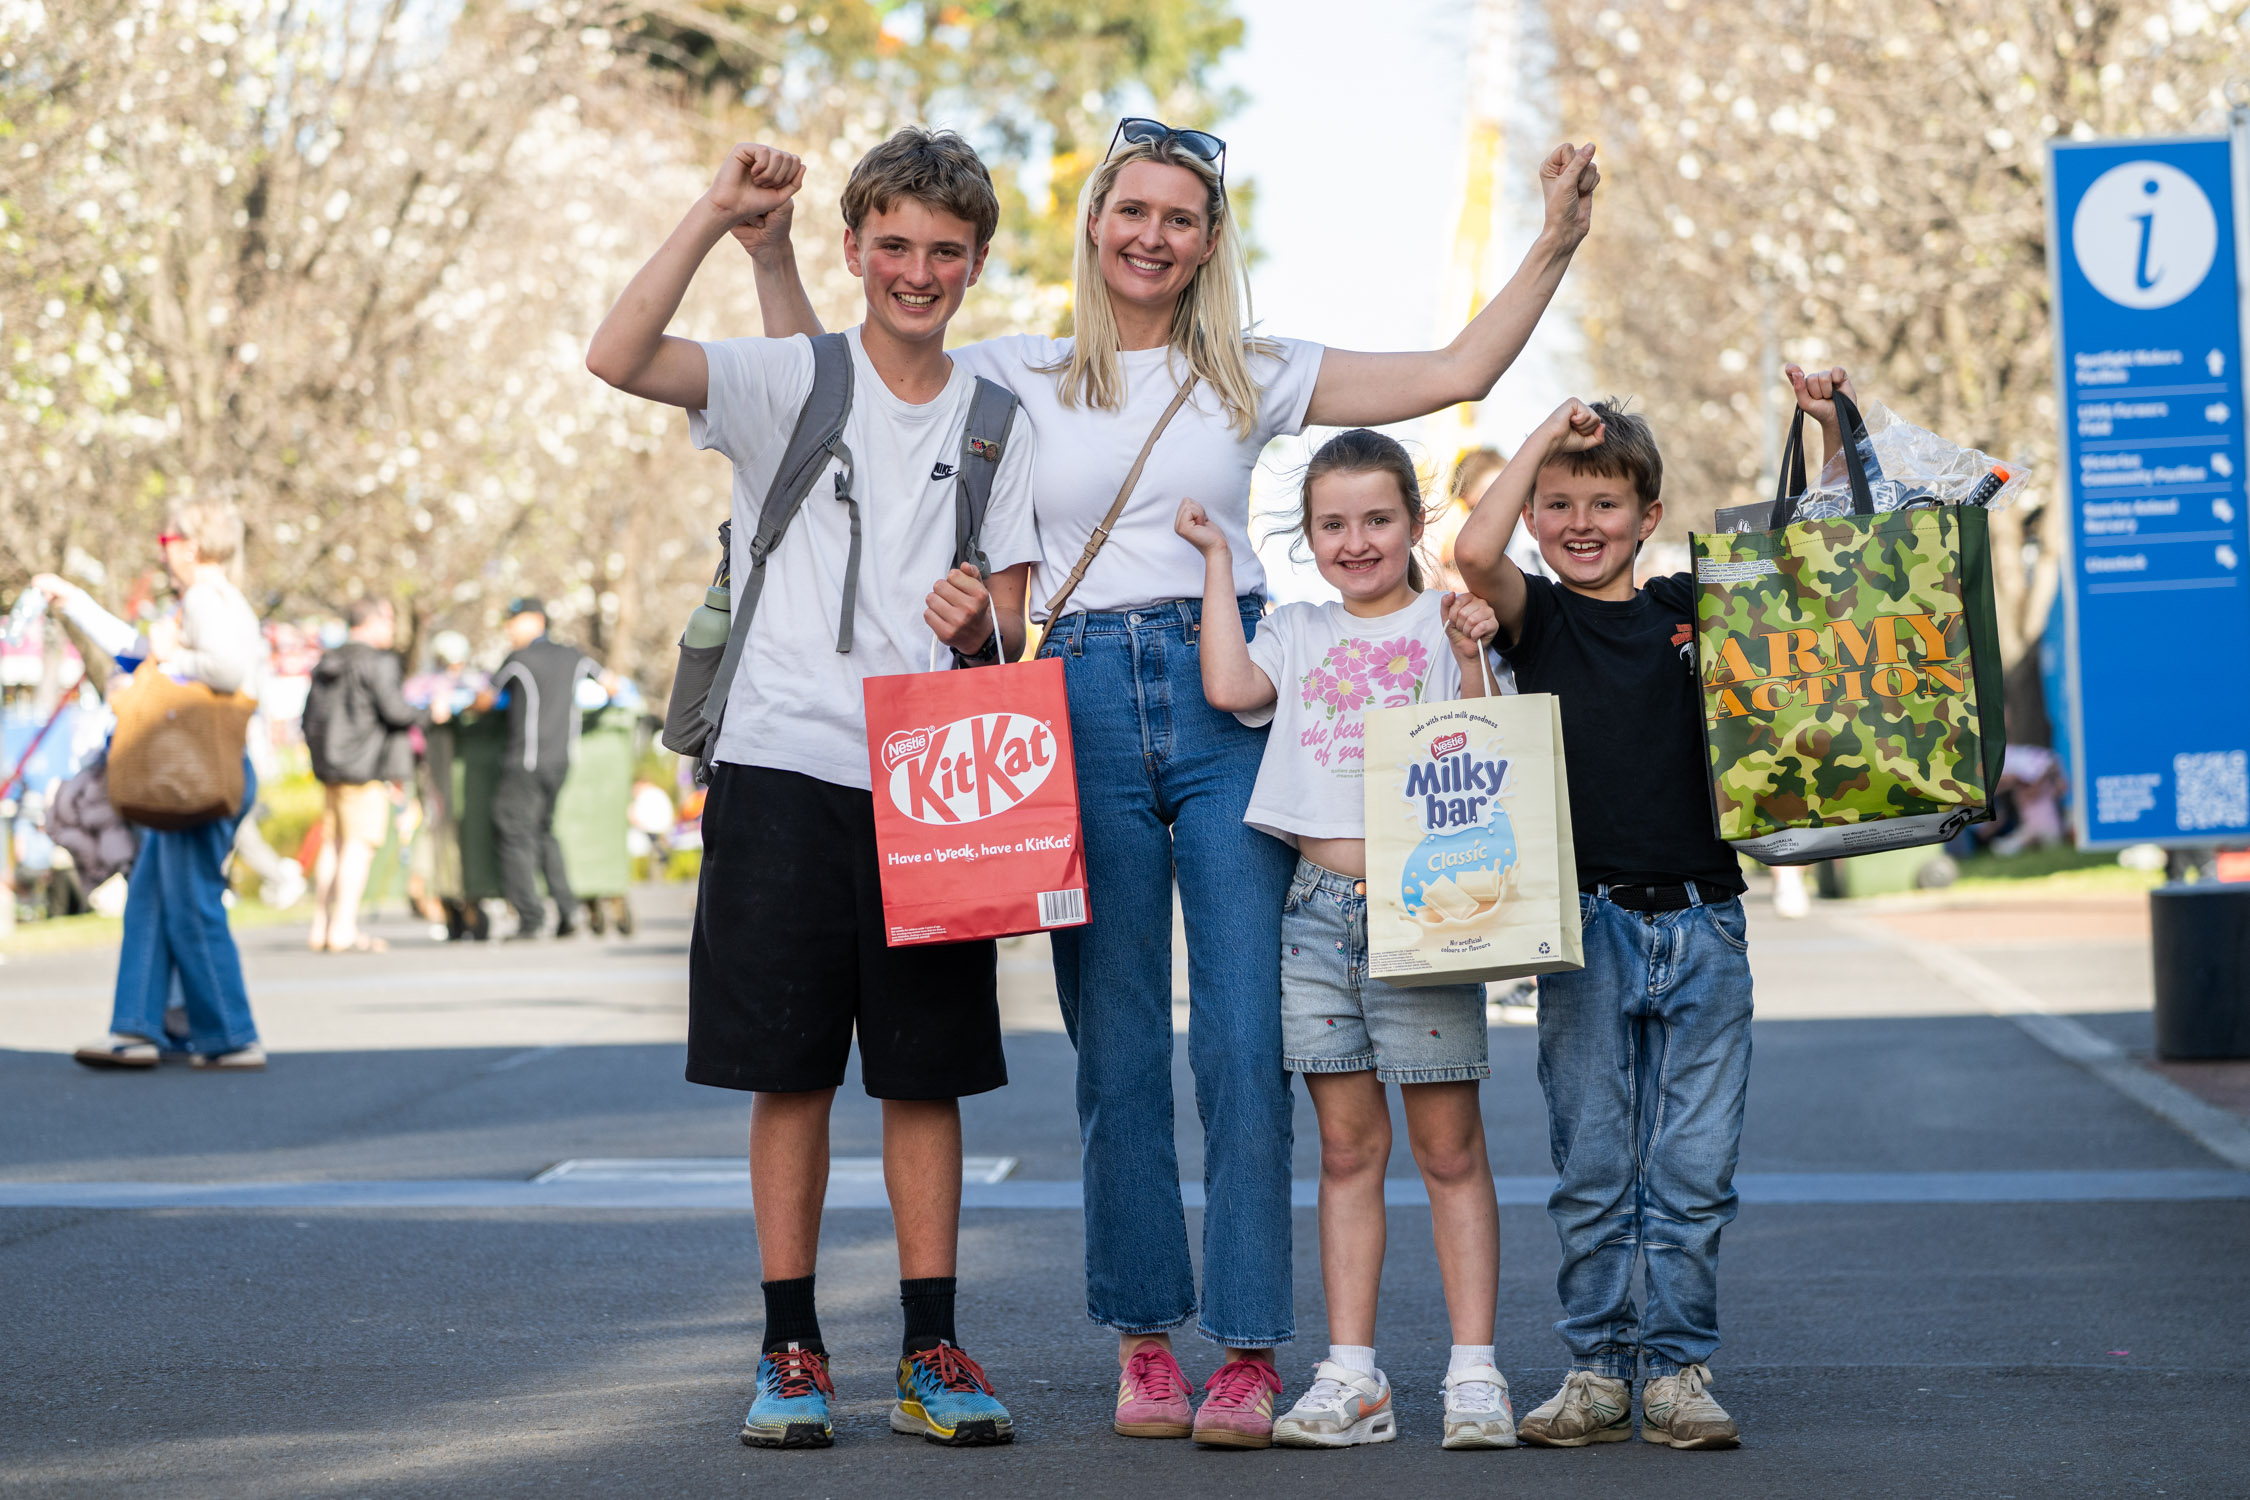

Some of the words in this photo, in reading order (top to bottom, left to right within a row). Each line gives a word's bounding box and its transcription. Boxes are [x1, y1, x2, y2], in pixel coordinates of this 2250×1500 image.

[934, 461, 954, 475] NIKE
[1703, 611, 1964, 688] ARMY
[1708, 663, 1968, 721] ACTION
[1301, 720, 1328, 747] the
[1409, 724, 1425, 738] Made
[1425, 715, 1439, 727] with
[1440, 711, 1453, 721] real
[1454, 711, 1468, 719] milk
[1469, 714, 1498, 729] goodness
[888, 734, 926, 759] Nestlé
[1314, 739, 1332, 767] of
[1433, 735, 1464, 753] Nestlé
[907, 715, 1051, 823] KitKat
[1405, 752, 1508, 797] Milky
[1426, 793, 1487, 830] bar
[888, 852, 921, 866] Have
[924, 852, 932, 861] a
[936, 843, 979, 863] break,
[981, 843, 1011, 856] have
[1015, 843, 1023, 852] a
[1025, 835, 1070, 851] KitKat
[1427, 839, 1488, 873] Classic
[1767, 838, 1792, 847] AUSTRALIA
[1459, 936, 1482, 946] artificial
[1469, 942, 1491, 952] flavours
